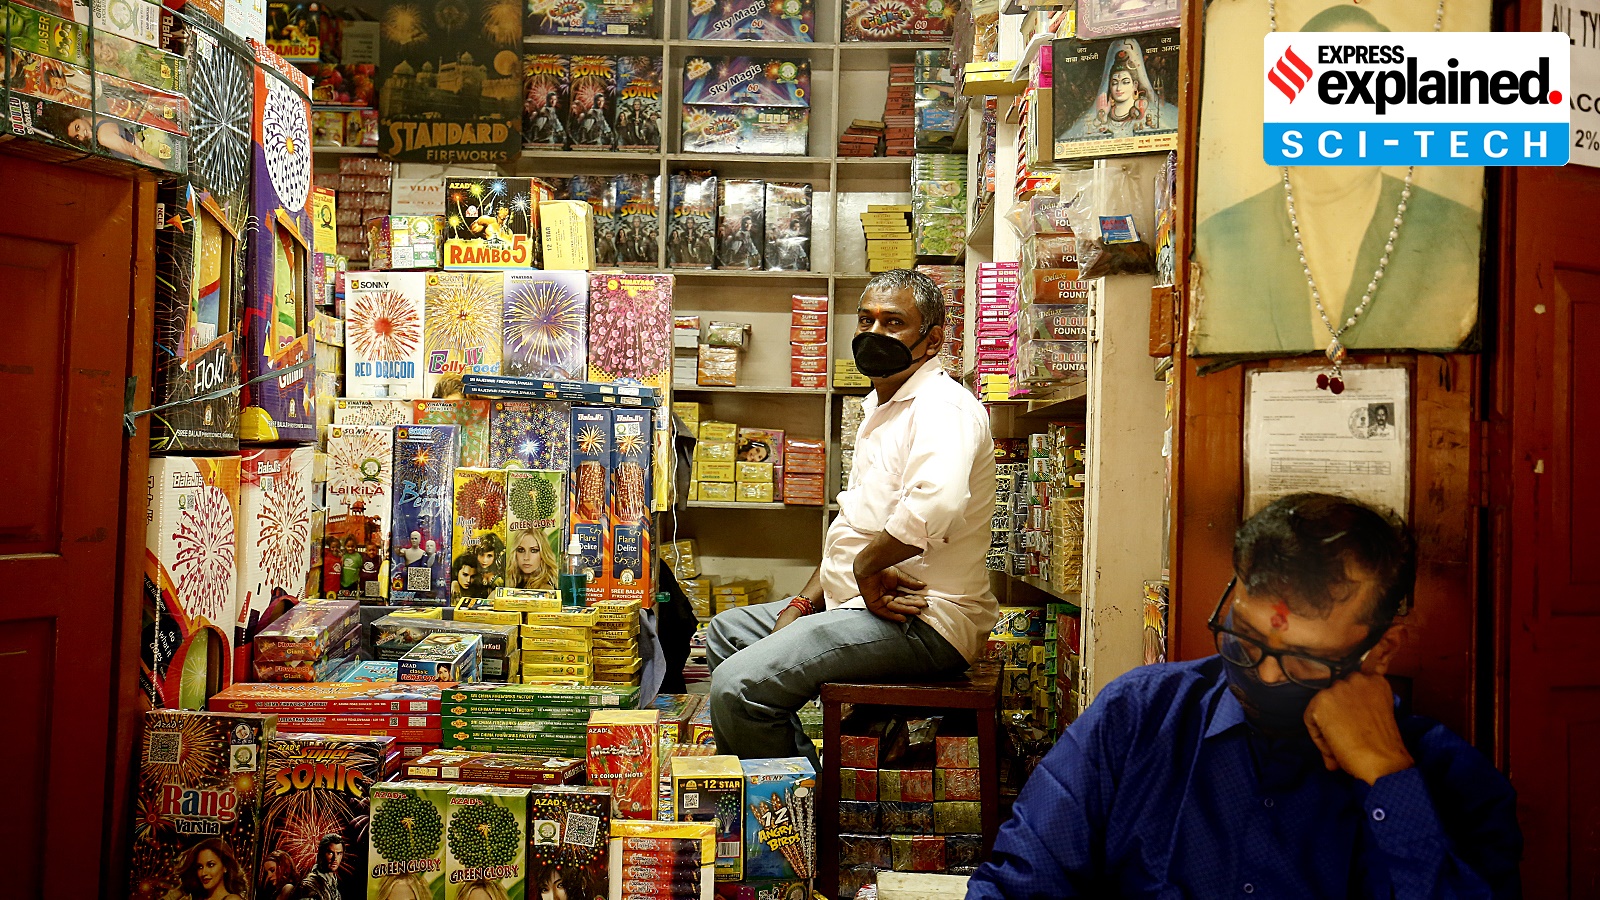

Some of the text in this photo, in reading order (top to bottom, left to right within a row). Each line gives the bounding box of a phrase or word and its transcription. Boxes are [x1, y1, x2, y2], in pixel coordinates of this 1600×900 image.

[570, 18, 582, 27] 60
[713, 0, 766, 32] Sky Magic
[751, 19, 764, 28] 60
[914, 20, 928, 29] 60
[38, 15, 51, 52] LASER
[307, 37, 317, 56] 5
[526, 64, 565, 77] SONIC
[573, 65, 611, 78] SONIC
[709, 64, 762, 96] Sky Magic
[621, 87, 659, 100] SONIC
[747, 83, 759, 92] 60
[1575, 130, 1600, 151] 2%
[426, 150, 507, 161] FIREWORKS
[620, 203, 658, 218] SONIC
[674, 205, 711, 219] SONIC
[450, 235, 527, 264] RAMBO 5
[1043, 272, 1067, 283] Deluxe
[360, 281, 390, 289] SONNY
[1038, 308, 1063, 318] Deluxe
[355, 361, 415, 379] RED DRAGON
[329, 485, 386, 496] Lal KiLA
[509, 518, 556, 532] GREEN GLORY
[579, 533, 597, 542] Flare
[618, 535, 636, 543] Flare
[617, 544, 637, 552] Delite
[288, 746, 355, 762] Super
[275, 762, 364, 799] SONIC
[703, 779, 741, 789] 12 STAR
[373, 791, 408, 799] AZAD's
[450, 797, 484, 806] AZAD's
[161, 784, 237, 822] Rang
[534, 798, 568, 807] AZAD's
[762, 807, 790, 829] 12
[174, 818, 221, 835] Varsha
[758, 824, 794, 845] ANGRY
[767, 833, 802, 852] BIRDS
[371, 857, 442, 878] GREEN GLORY
[449, 864, 520, 884] GREEN GLORY
